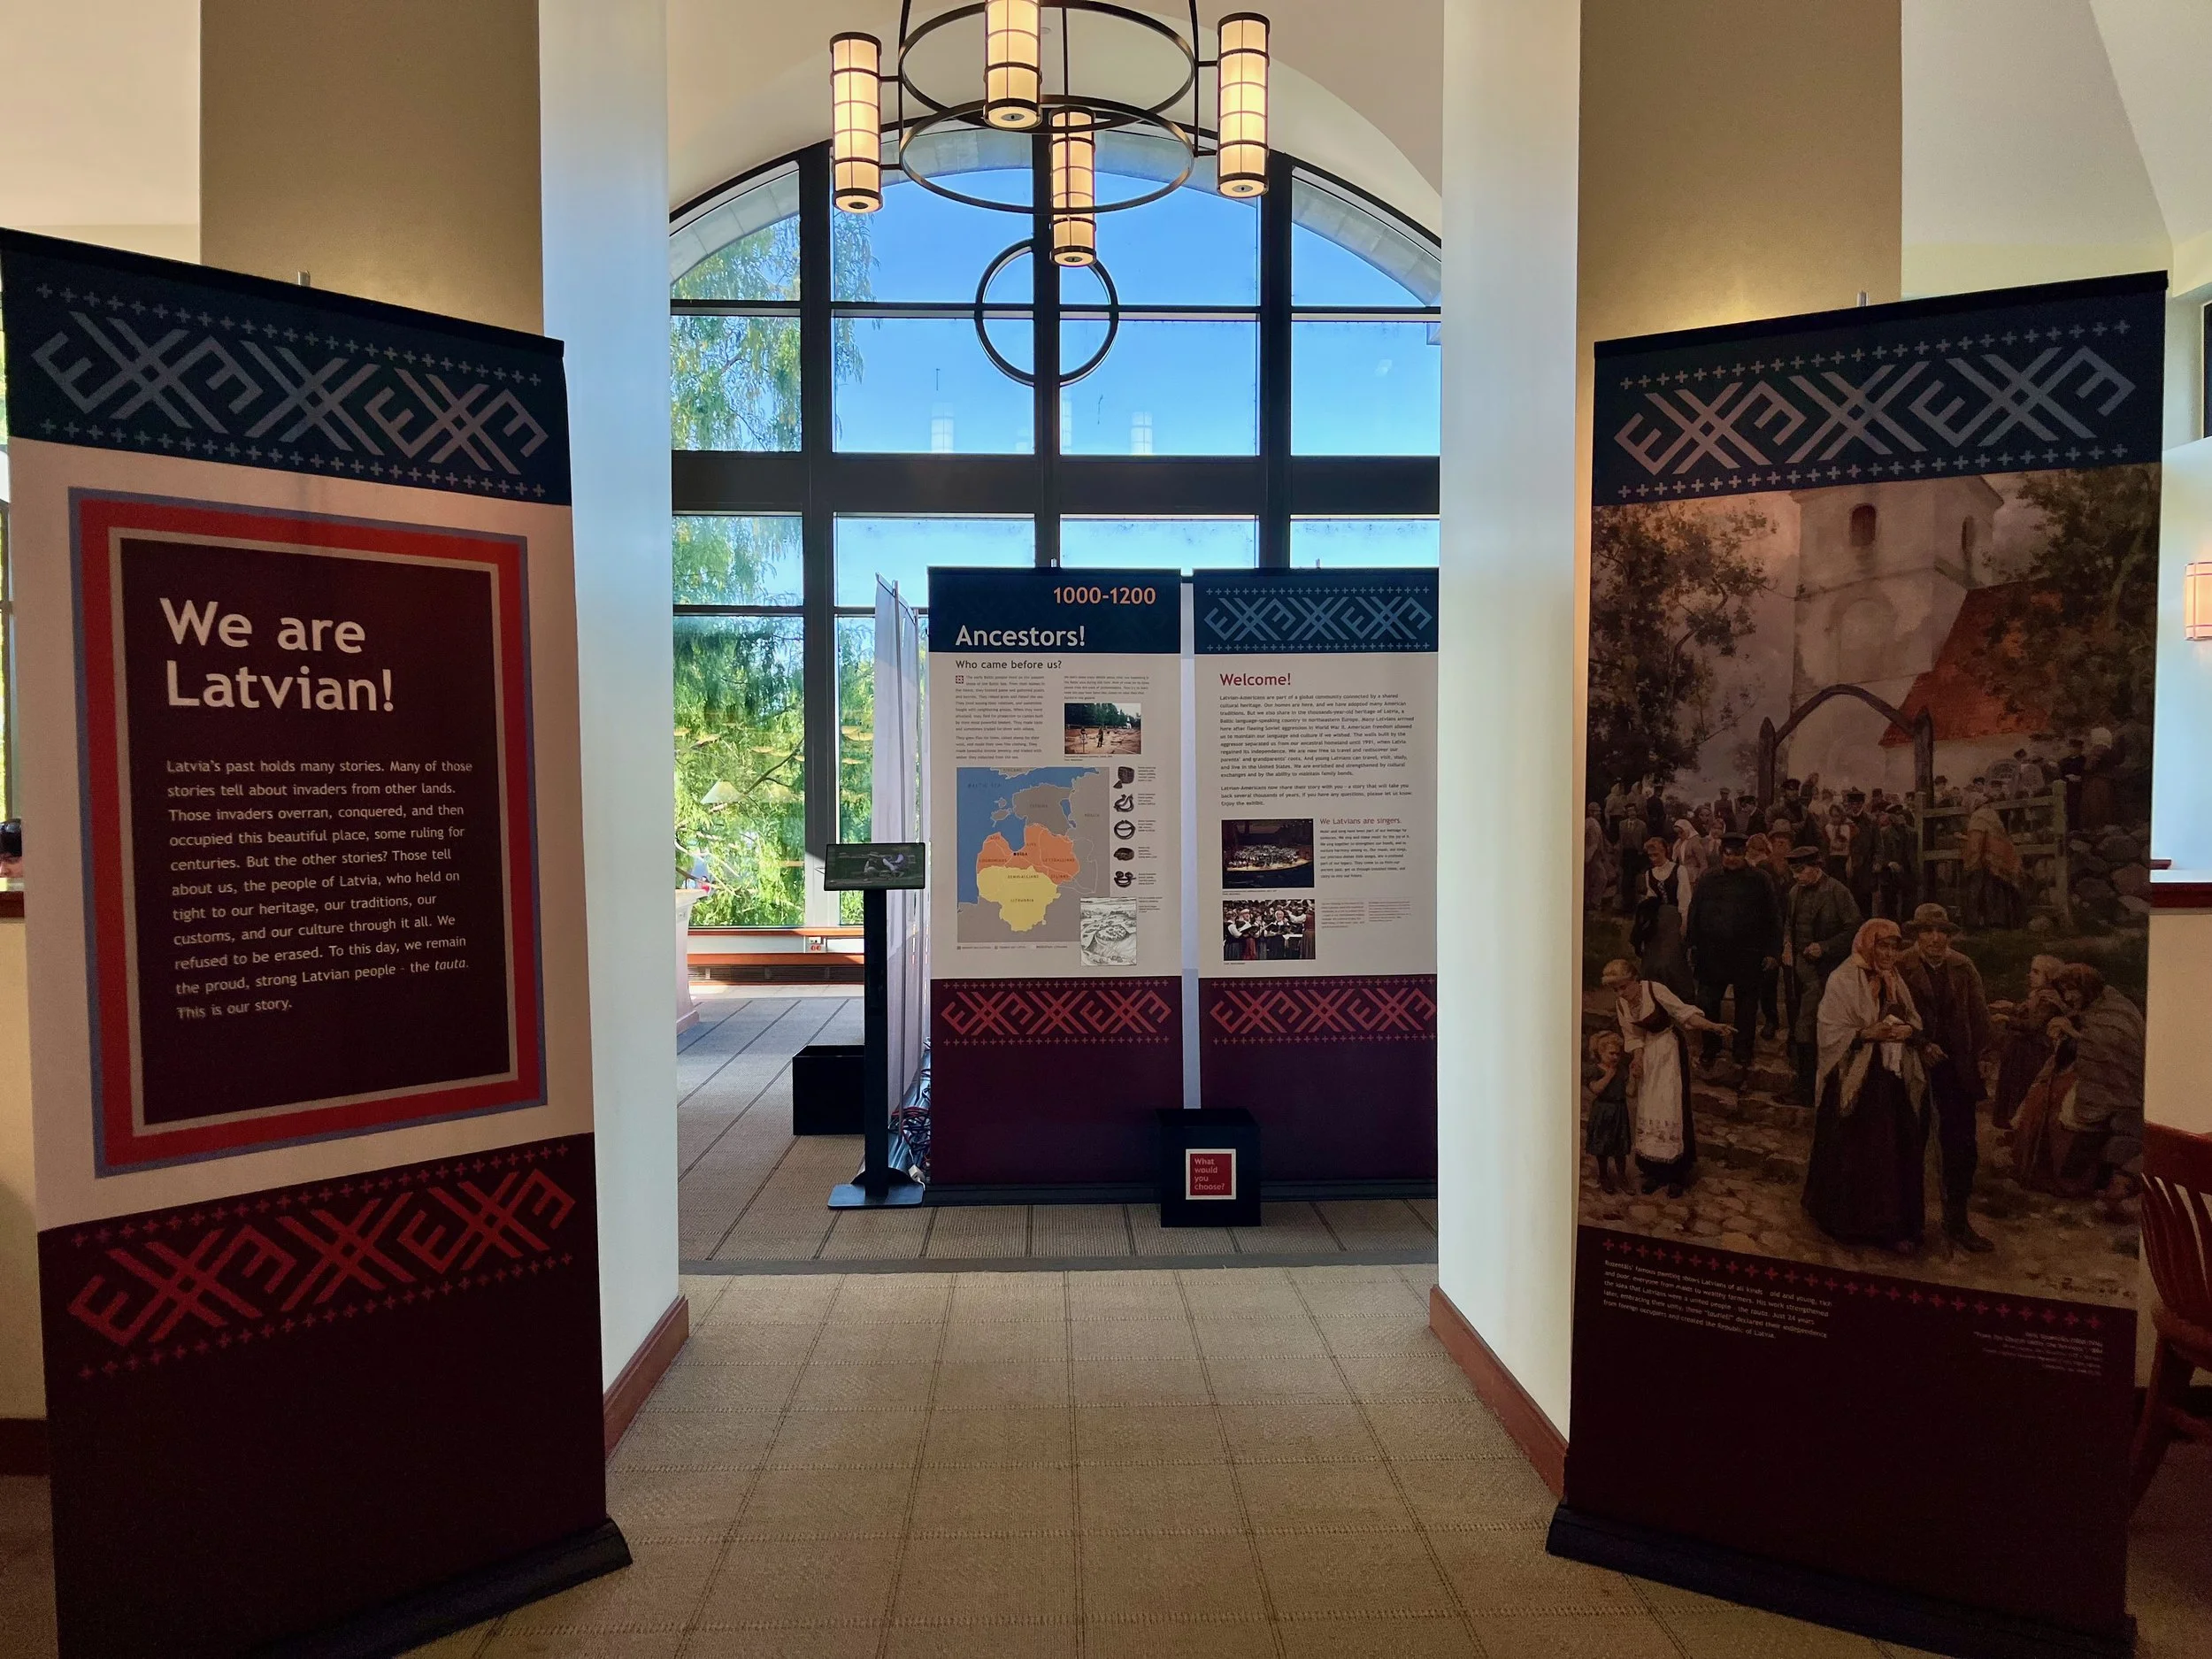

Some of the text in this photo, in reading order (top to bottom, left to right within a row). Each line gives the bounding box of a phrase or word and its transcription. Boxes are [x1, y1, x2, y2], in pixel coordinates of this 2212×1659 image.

[1053, 587, 1156, 605] 1000-1200
[159, 596, 366, 654] We are
[955, 625, 1087, 647] Ancestors!
[956, 659, 1063, 670] Who came before us?
[165, 659, 395, 712] Latvian!
[1219, 672, 1292, 687] Welcome!
[165, 759, 473, 775] Latvia's past holds many stories. Many of those
[166, 781, 456, 797] stories tell about invaders from other lands.
[167, 803, 465, 821] Those invaders overran, conquered, and then
[1377, 817, 1402, 826] singers.
[168, 826, 465, 848] occupied this beautiful place, some ruling for
[170, 848, 452, 872] centuries. But the other stories? Those tell
[171, 870, 460, 896] about us, the people of Latvia, who held on
[172, 895, 437, 923] tight to our heritage, our traditions, our
[173, 914, 456, 946] customs, and our culture through it all. We
[174, 935, 466, 970] refused to be erased. To this day, we remain
[175, 958, 469, 995] the proud, strong Latvian people the tauta.
[175, 999, 293, 1019] This is our story.
[1194, 1175, 1209, 1184] you
